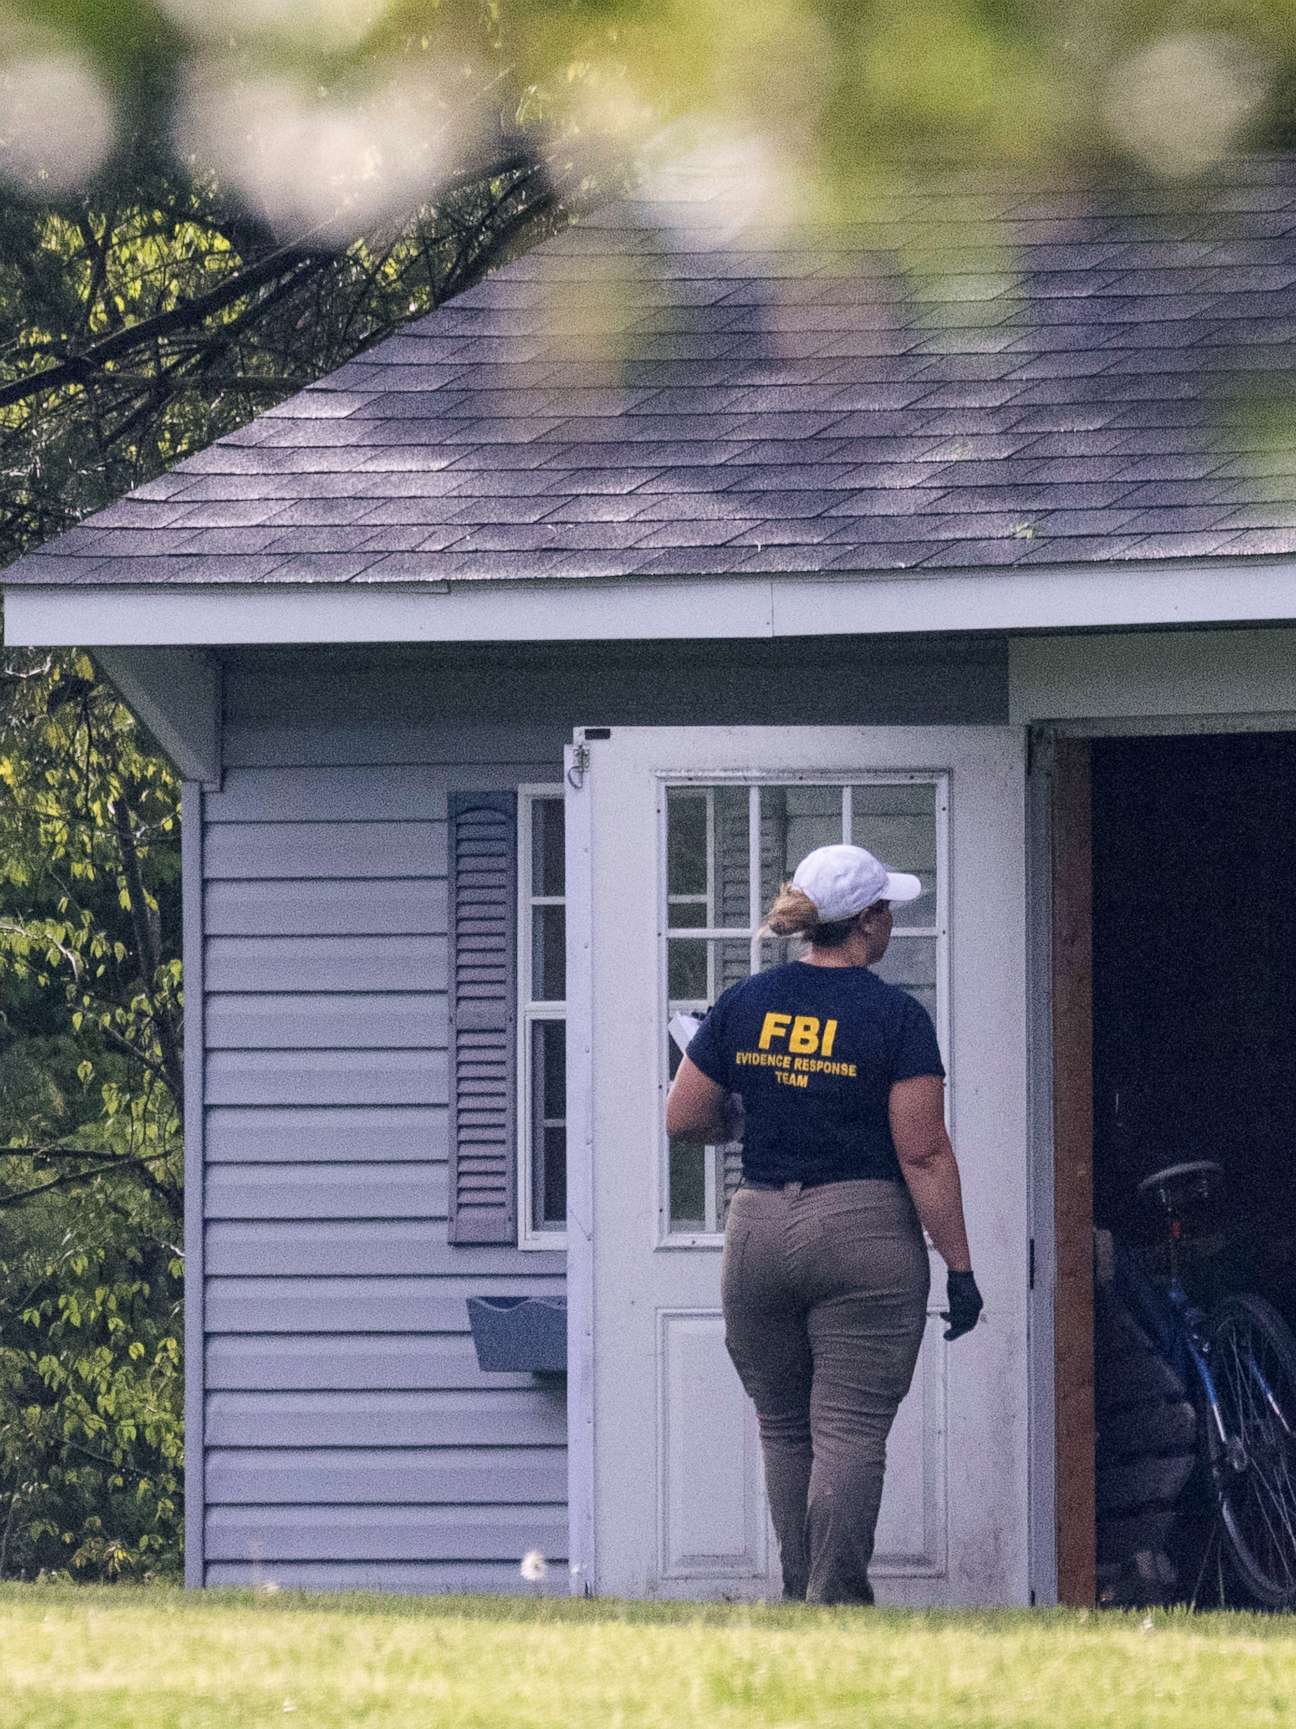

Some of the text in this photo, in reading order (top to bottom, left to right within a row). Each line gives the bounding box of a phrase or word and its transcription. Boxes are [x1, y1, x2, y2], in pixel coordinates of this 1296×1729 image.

[758, 1012, 838, 1056] FBI
[736, 1051, 857, 1077] EVIDENCE RESPONSE
[775, 1071, 808, 1088] TEAM
